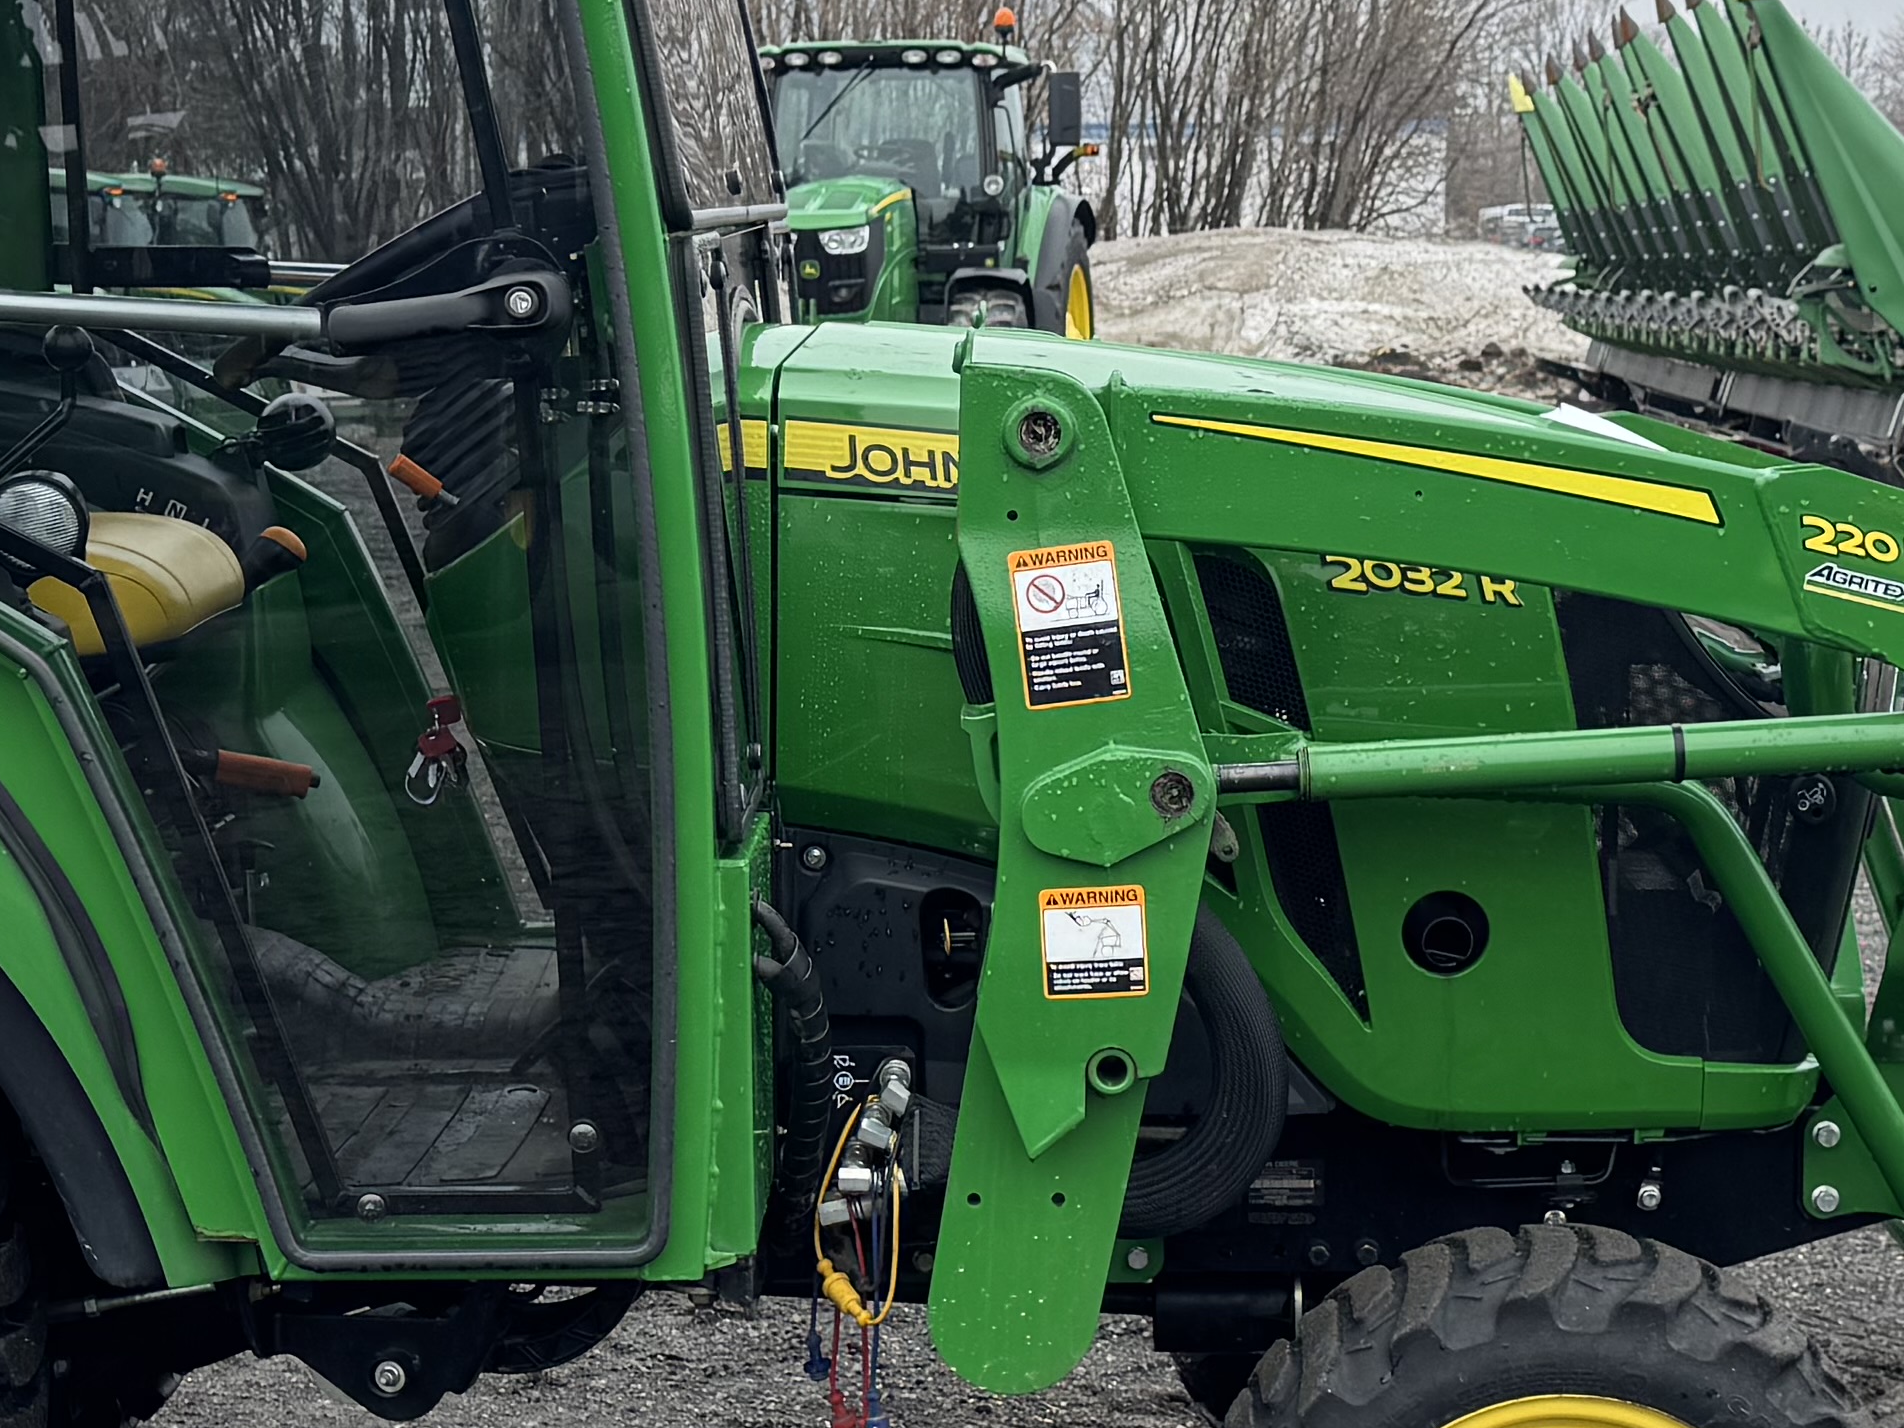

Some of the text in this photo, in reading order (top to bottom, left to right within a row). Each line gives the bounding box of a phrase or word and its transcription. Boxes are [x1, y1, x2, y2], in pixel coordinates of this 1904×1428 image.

[136, 488, 153, 506] H
[1801, 515, 1900, 562] 220
[1029, 545, 1108, 567] WARNING
[1324, 555, 1467, 599] 2032
[1059, 889, 1138, 905] WARNING
